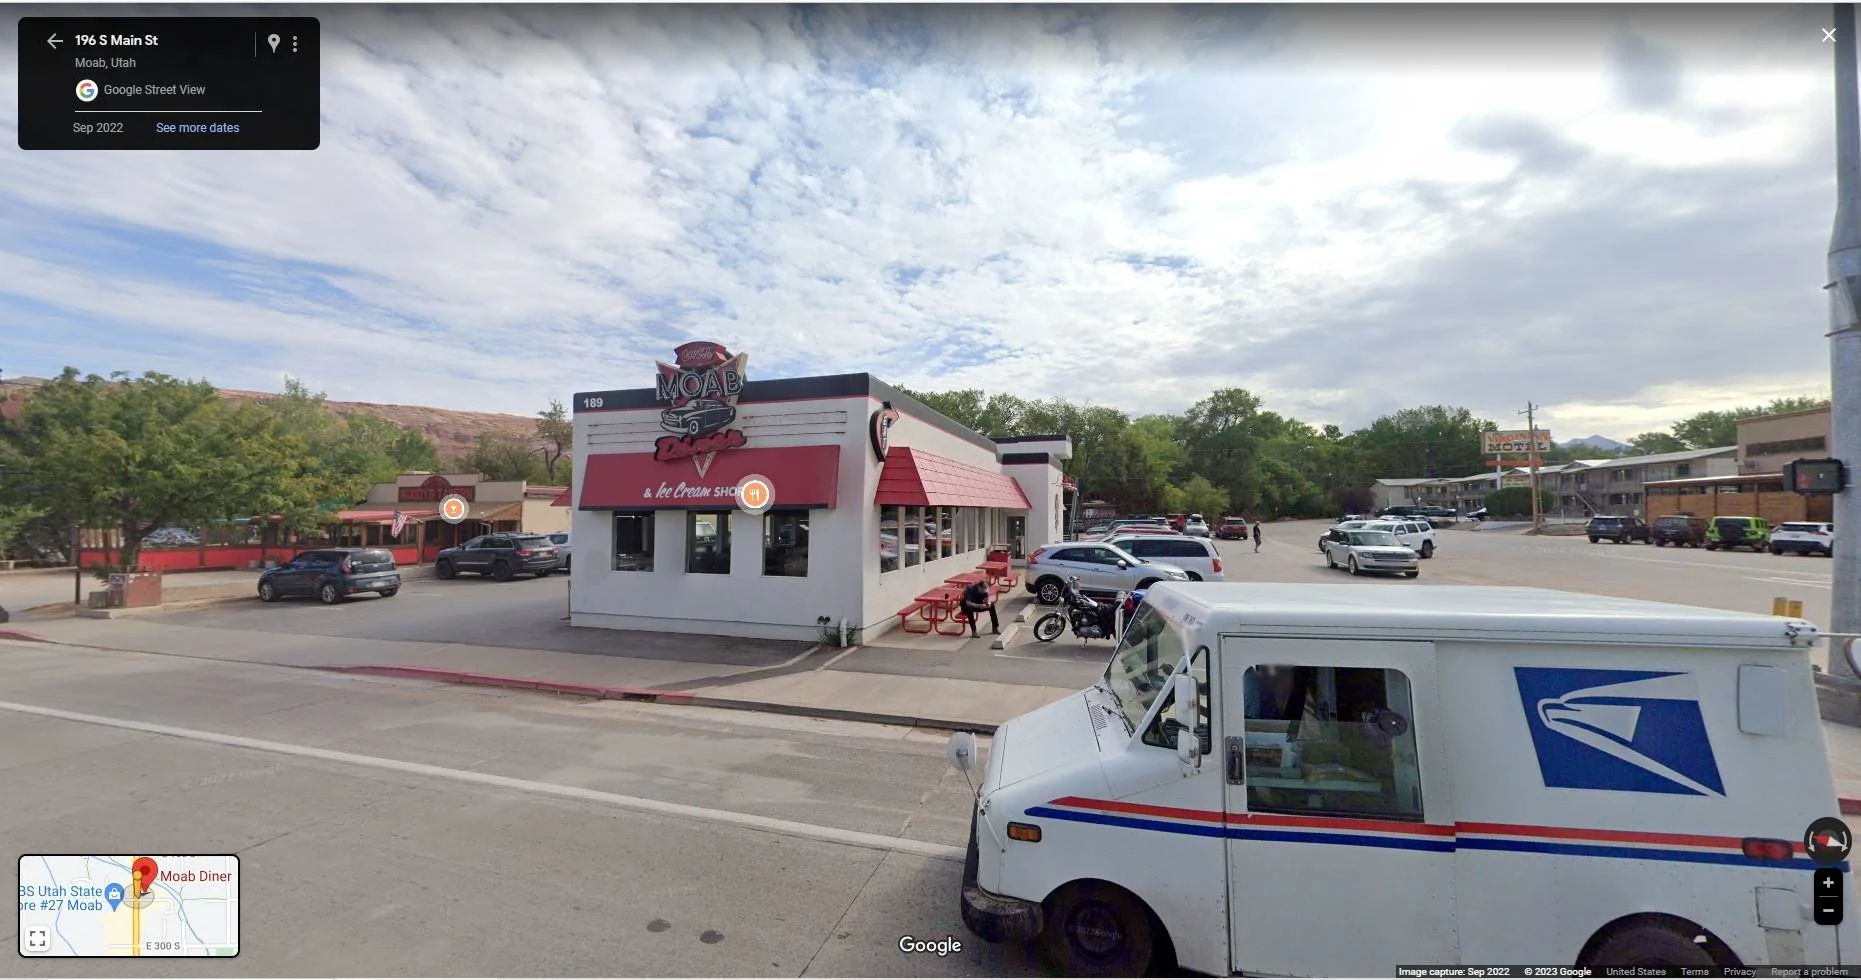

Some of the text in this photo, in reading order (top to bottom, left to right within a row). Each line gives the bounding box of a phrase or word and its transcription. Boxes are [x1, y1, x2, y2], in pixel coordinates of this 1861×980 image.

[656, 369, 742, 400] MOAB
[583, 397, 604, 409] 189
[643, 487, 653, 498] &
[656, 481, 673, 498] Ice
[673, 481, 711, 498] Cream
